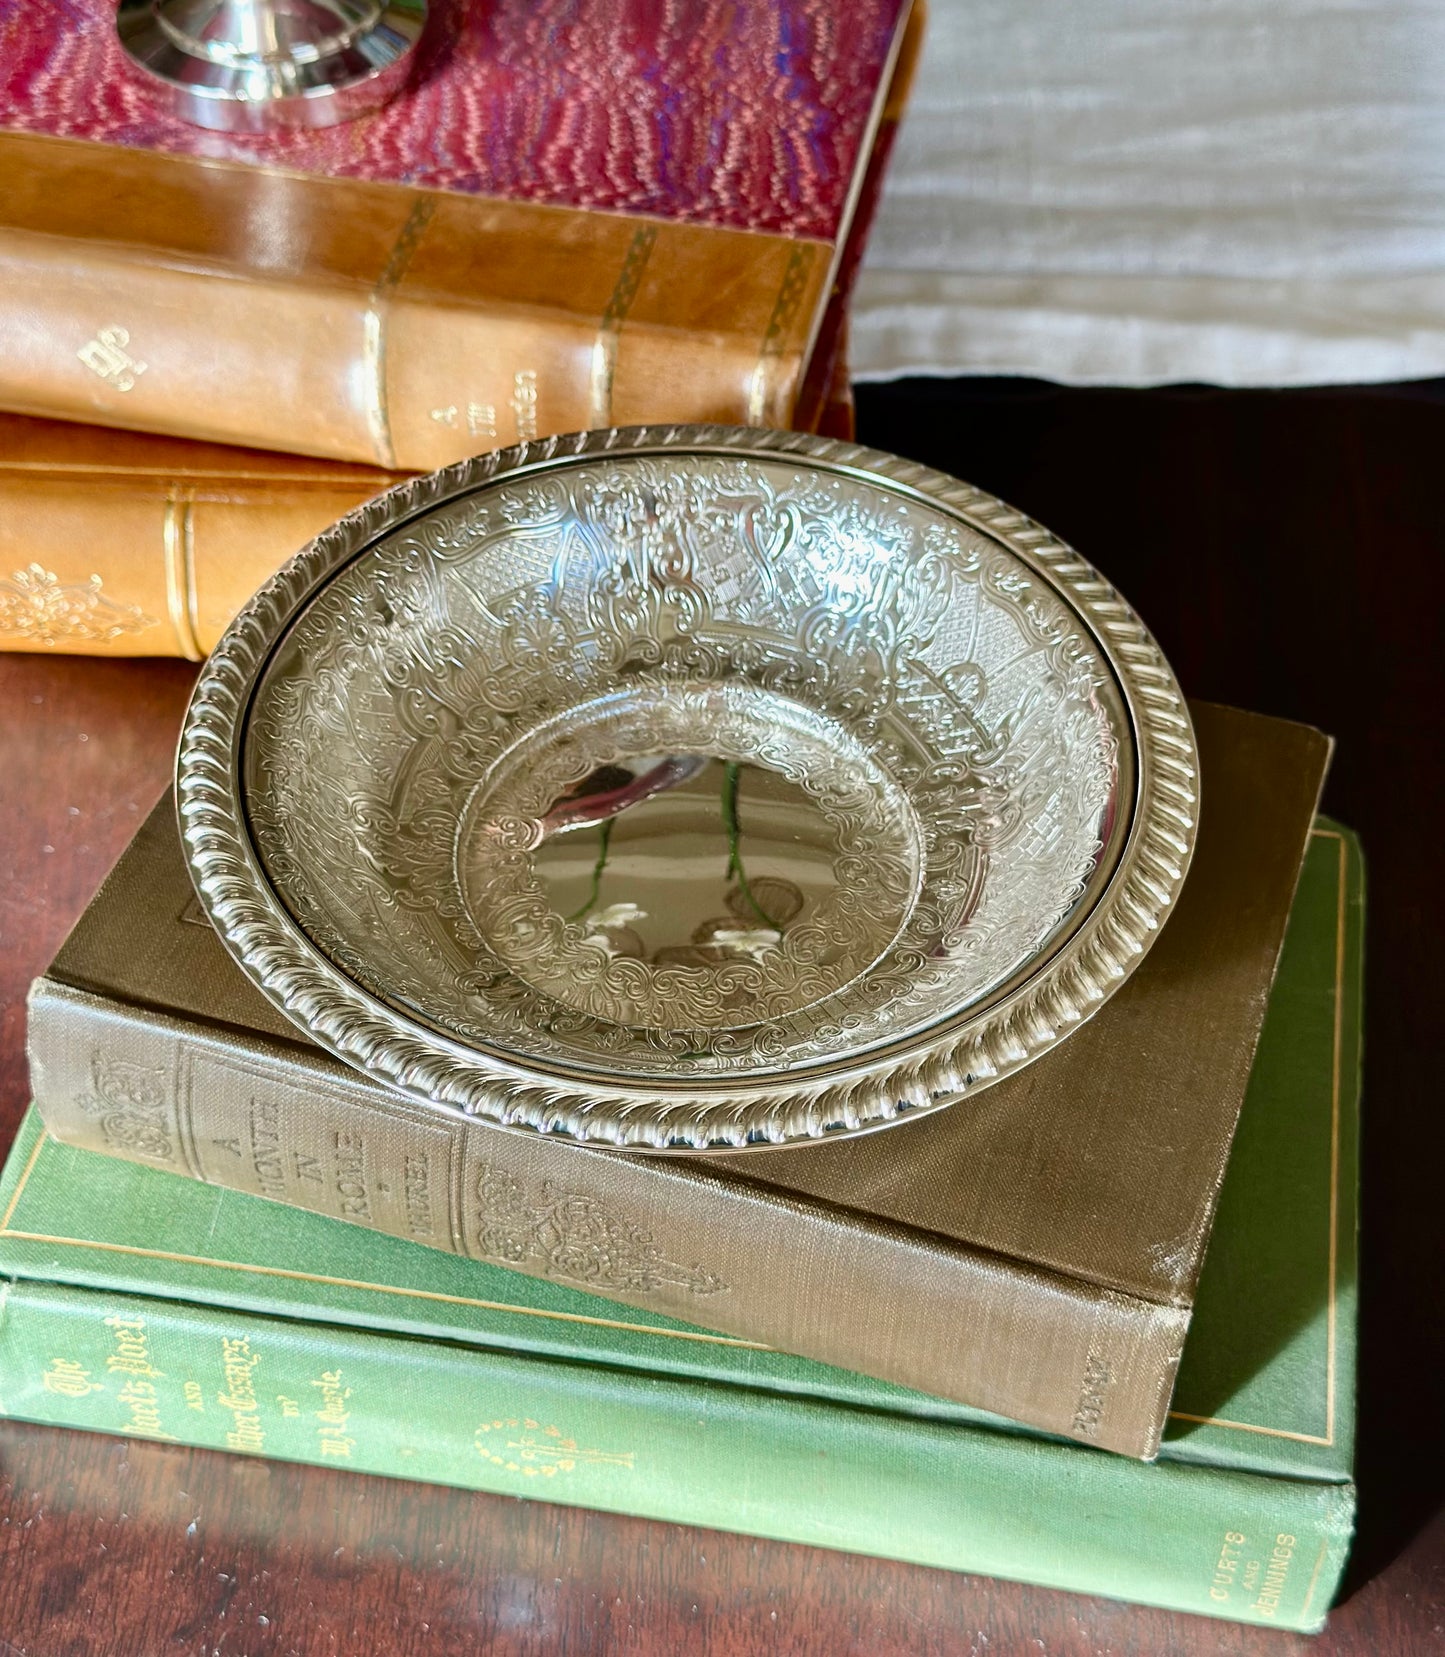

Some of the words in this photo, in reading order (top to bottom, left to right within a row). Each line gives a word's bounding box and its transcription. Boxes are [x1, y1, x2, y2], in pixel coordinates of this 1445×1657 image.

[213, 1138, 241, 1157] A
[294, 1150, 323, 1184] IN
[335, 1131, 371, 1220] ROME
[103, 1315, 166, 1378] Poet
[184, 1380, 205, 1412] AND
[1210, 1531, 1245, 1601] CURTS
[1242, 1560, 1260, 1589] AND
[1251, 1533, 1296, 1616] JENNINGS
